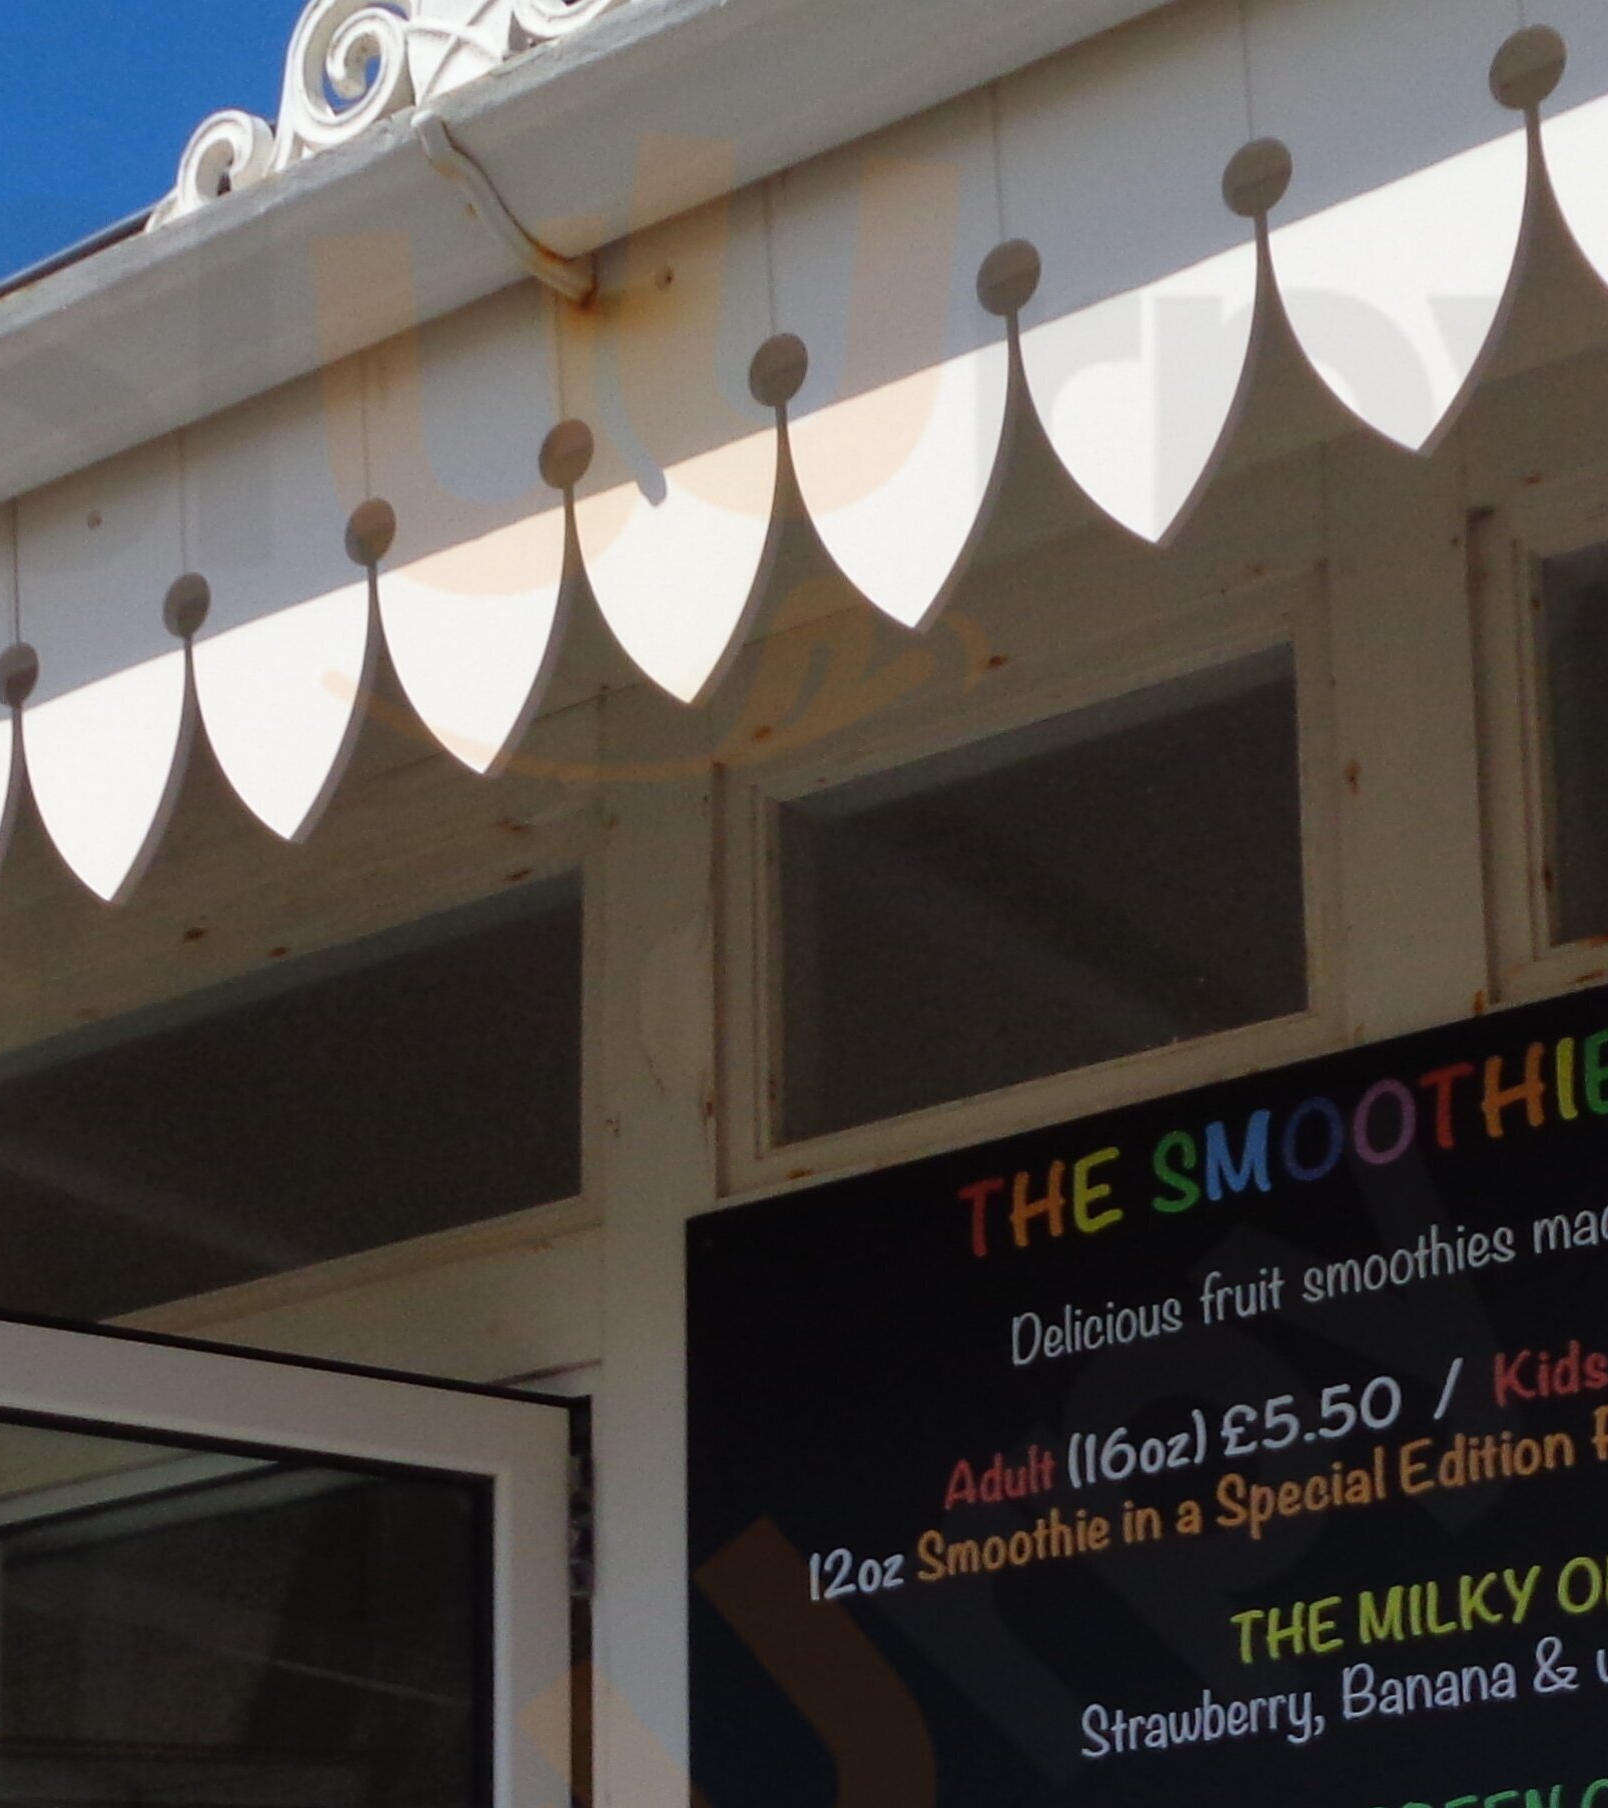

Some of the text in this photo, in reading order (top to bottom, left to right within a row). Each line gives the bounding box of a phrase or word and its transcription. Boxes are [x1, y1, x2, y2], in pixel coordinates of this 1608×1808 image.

[958, 1146, 1124, 1257] THE
[1011, 1297, 1184, 1366] Delicious
[1199, 1266, 1285, 1325] fruit
[1301, 1223, 1516, 1303] smoothies
[943, 1444, 1056, 1511] Adult
[1068, 1408, 1207, 1489] (16oz)
[1220, 1375, 1402, 1457] £5.50
[1432, 1357, 1463, 1421] /
[809, 1547, 905, 1602] 12oz
[916, 1507, 1111, 1582] Smoothie
[1122, 1499, 1162, 1544] in
[1175, 1499, 1203, 1535] a
[1215, 1445, 1387, 1541] Special
[1399, 1430, 1576, 1496] Edition
[1229, 1595, 1345, 1664] THE
[1358, 1565, 1542, 1645] MILKY
[1081, 1689, 1326, 1759] Strawberry,
[1341, 1662, 1517, 1721] Banana
[1532, 1636, 1580, 1694] &
